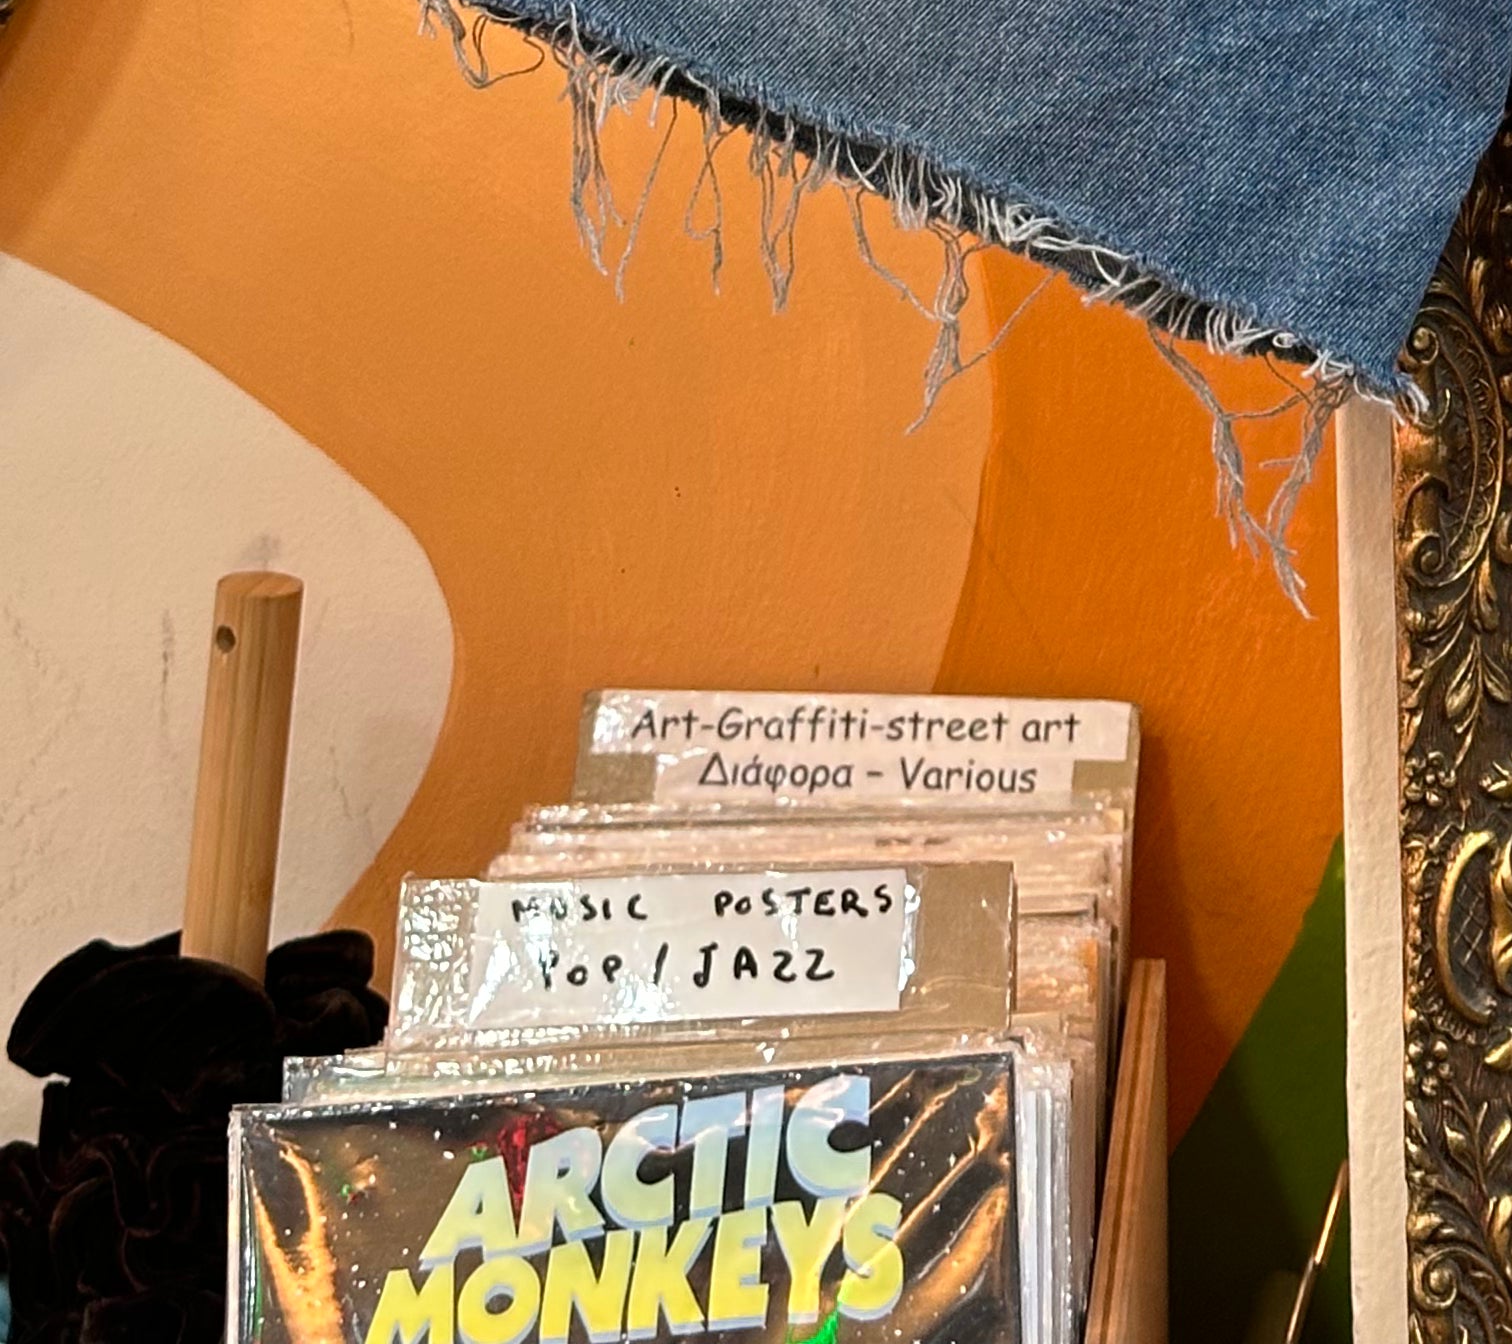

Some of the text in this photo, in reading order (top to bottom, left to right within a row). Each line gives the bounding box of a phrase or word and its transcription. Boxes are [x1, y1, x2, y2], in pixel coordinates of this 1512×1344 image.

[630, 705, 1082, 745] Art-Graffiti-street art
[699, 751, 856, 794] Διάφορα
[899, 757, 1038, 794] Various
[511, 883, 893, 923] MUSIC POSTERS
[692, 941, 836, 989] JAZZ
[418, 1073, 873, 1271] ARCTIC
[362, 1191, 903, 1344] MONKEYS
